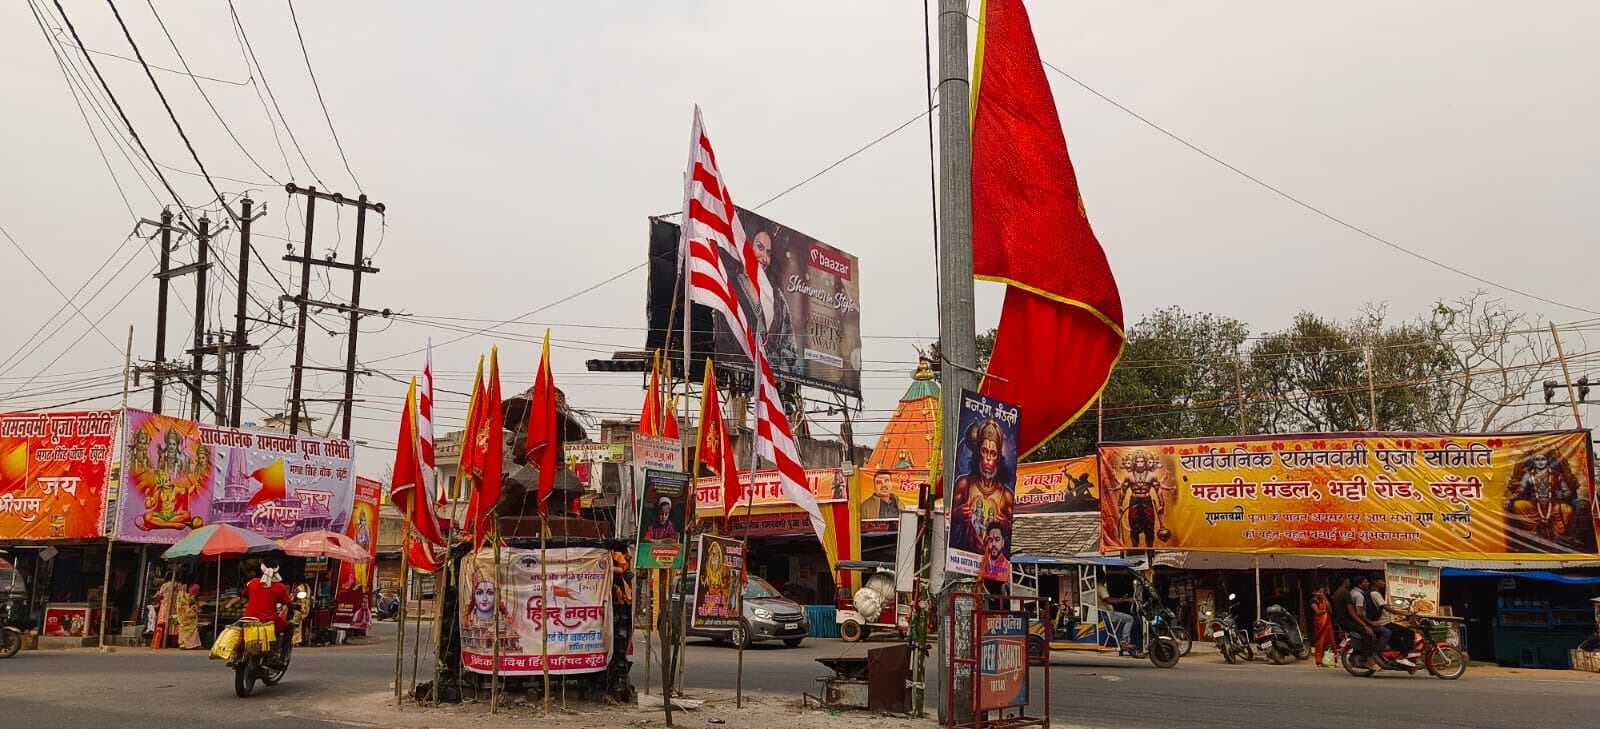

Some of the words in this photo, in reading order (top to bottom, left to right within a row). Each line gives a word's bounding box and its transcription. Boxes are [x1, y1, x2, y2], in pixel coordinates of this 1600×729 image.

[819, 251, 849, 274] baazar
[834, 291, 859, 313] Style
[2, 412, 49, 437] रामनवमी
[51, 416, 76, 444] पूजा
[77, 412, 113, 436] समिति
[256, 434, 298, 454] रामनवमी
[300, 439, 321, 461] पूजा
[323, 439, 351, 460] समिति
[1181, 447, 1273, 470] सार्वजनिक
[1280, 443, 1368, 468] रामनवमी
[1376, 449, 1416, 473] पूजा
[1424, 443, 1493, 467] समिति
[37, 476, 81, 497] जय
[1192, 477, 1256, 502] महावीर
[1262, 476, 1322, 500] मंडल,
[1328, 475, 1367, 501] भट्टी
[295, 488, 335, 514] जय
[251, 501, 303, 530] श्रीराम
[1205, 505, 1244, 525] रामनवमी
[1283, 512, 1308, 521] पावन
[1311, 512, 1344, 521] अवसर
[1416, 512, 1433, 528] राम
